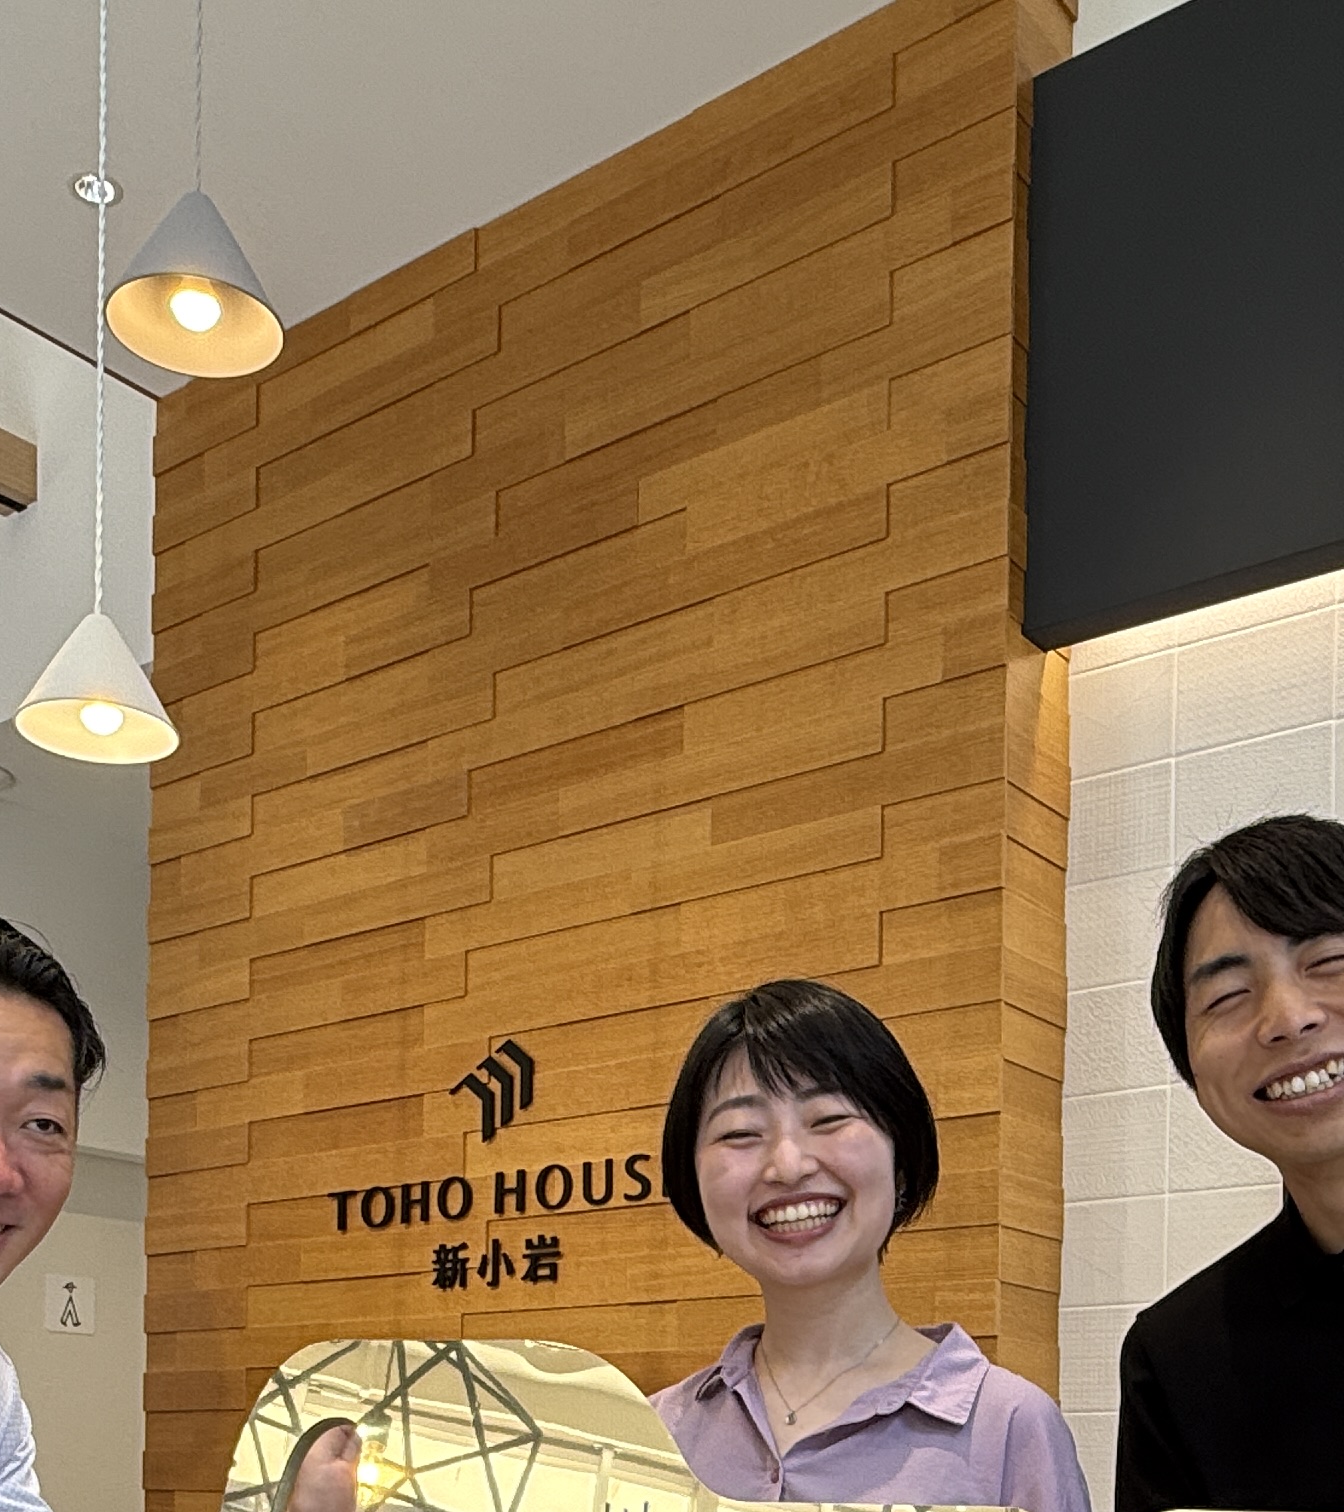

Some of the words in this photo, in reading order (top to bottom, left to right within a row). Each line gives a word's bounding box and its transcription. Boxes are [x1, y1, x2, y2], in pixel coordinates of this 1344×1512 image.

[328, 1176, 474, 1233] TOHO
[494, 1154, 670, 1216] HOUS
[431, 1234, 564, 1291] 新小岩
